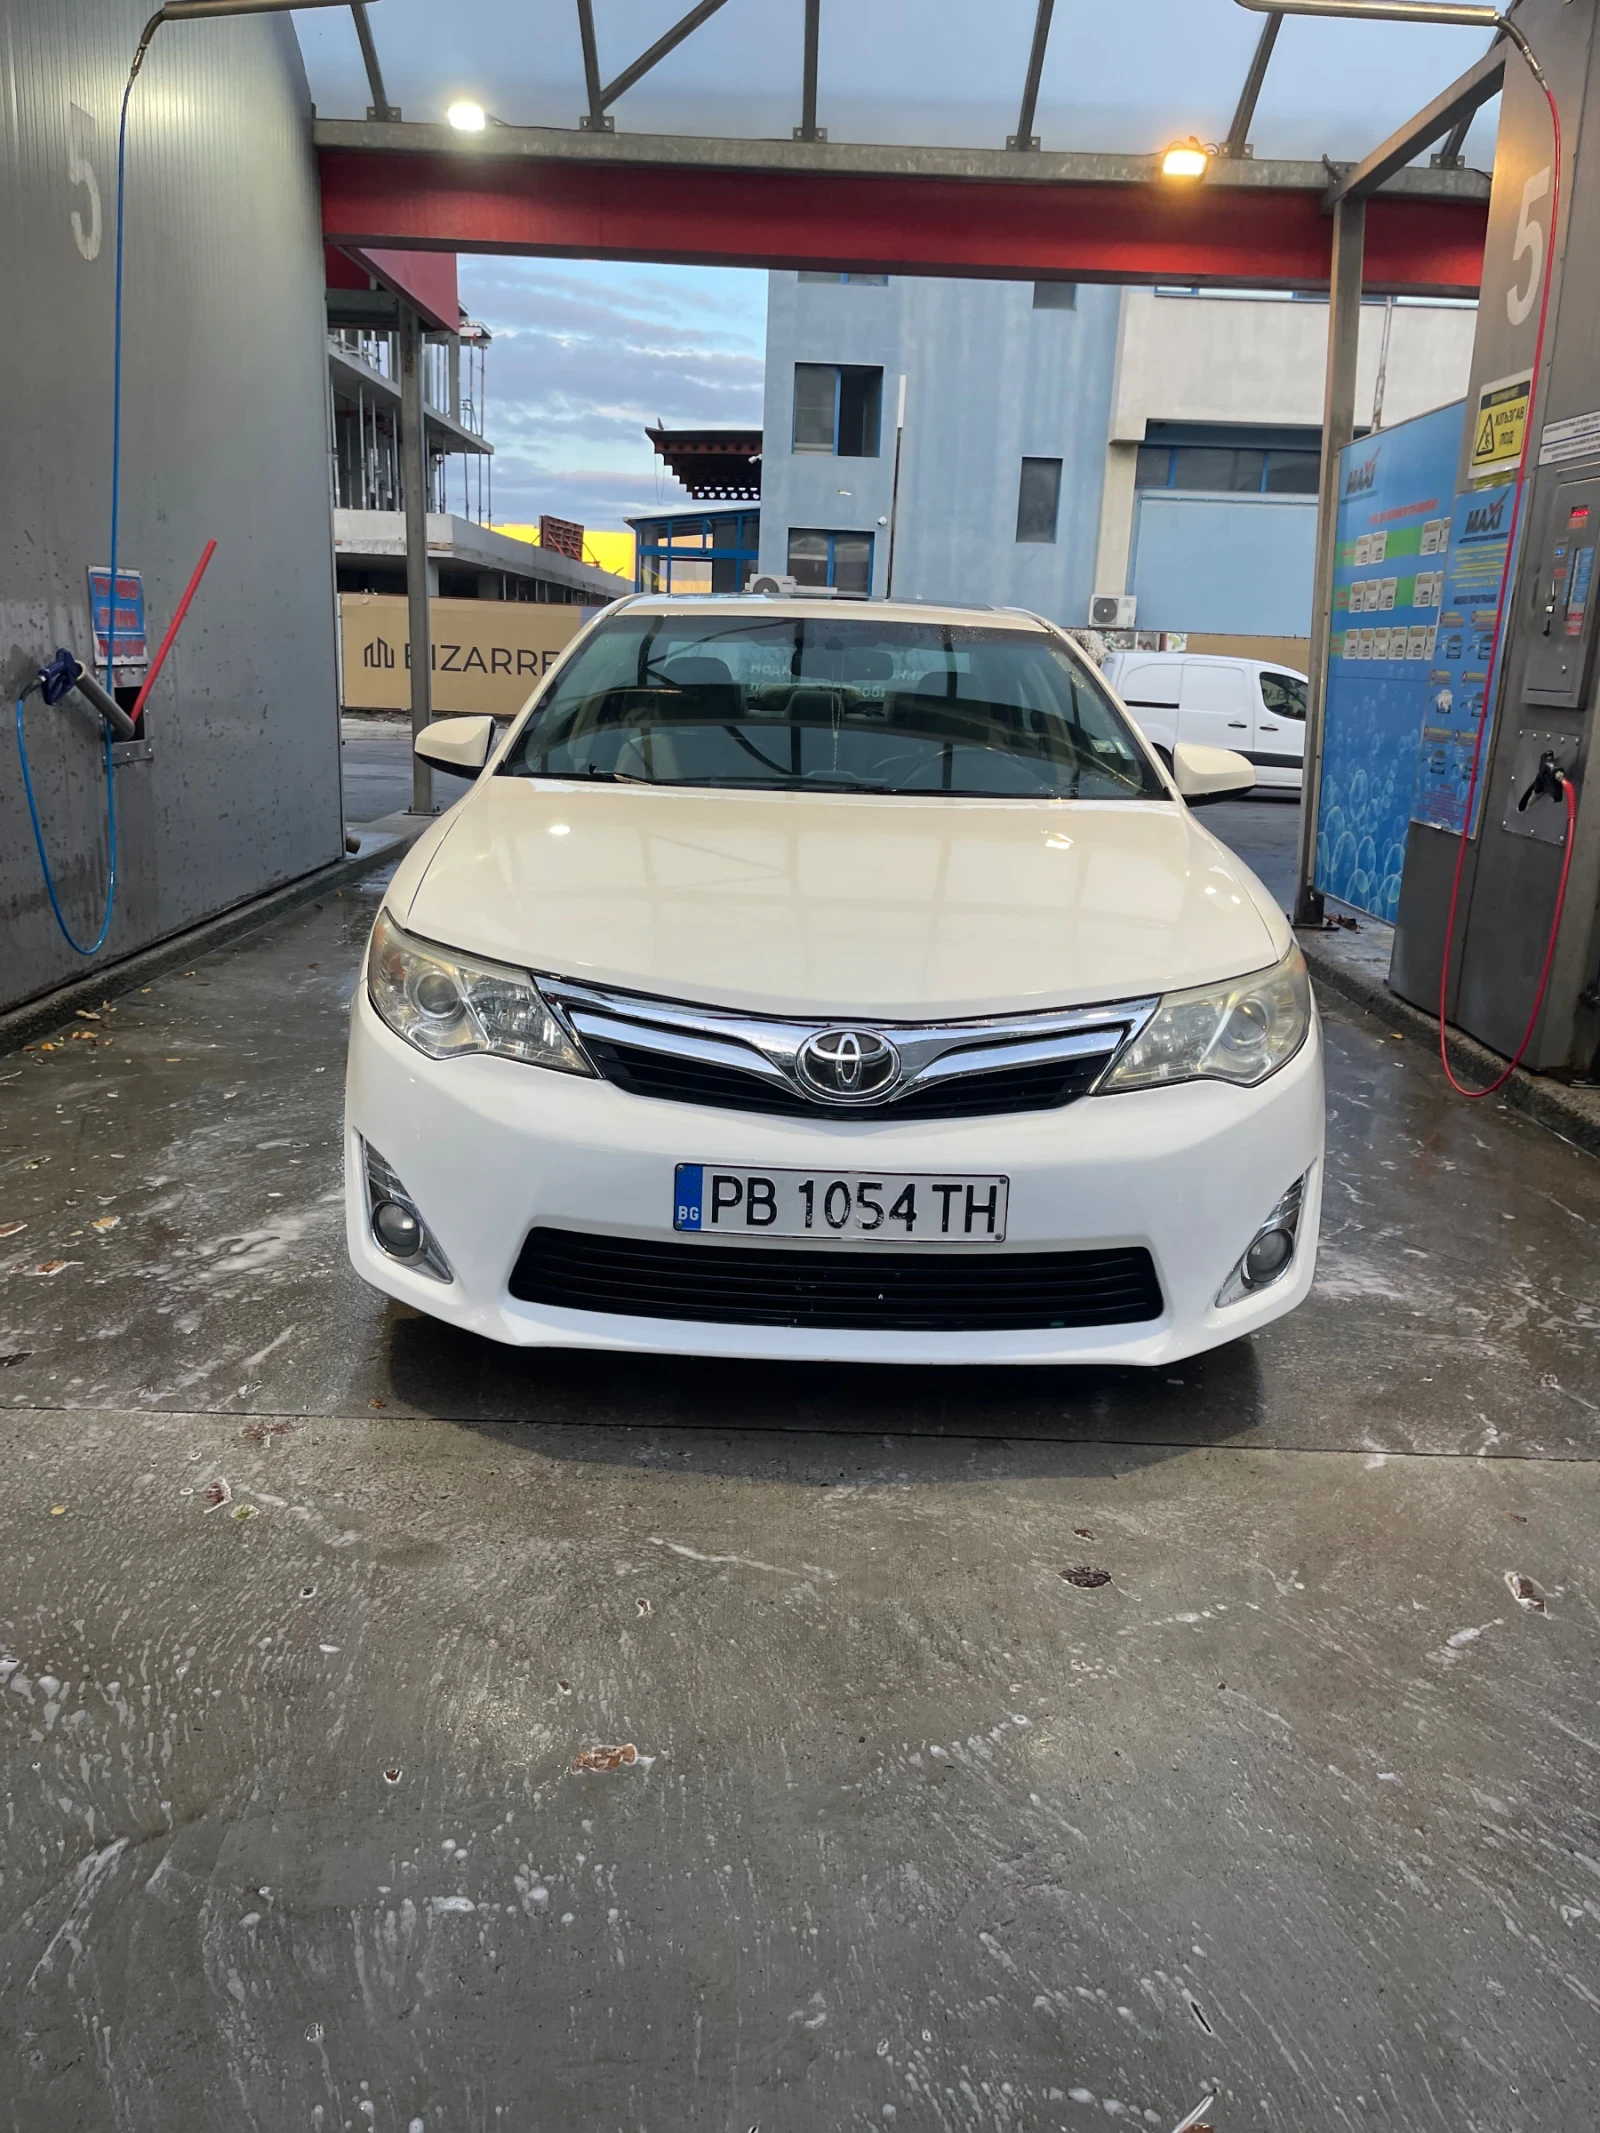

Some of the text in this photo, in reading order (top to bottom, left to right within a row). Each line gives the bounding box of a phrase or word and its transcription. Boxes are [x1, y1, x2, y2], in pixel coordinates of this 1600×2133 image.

[69, 101, 103, 262] 5
[1507, 165, 1550, 326] 5
[1465, 492, 1510, 534] MAXI
[678, 1205, 699, 1222] BG
[711, 1174, 998, 1233] PB 1054 TH
